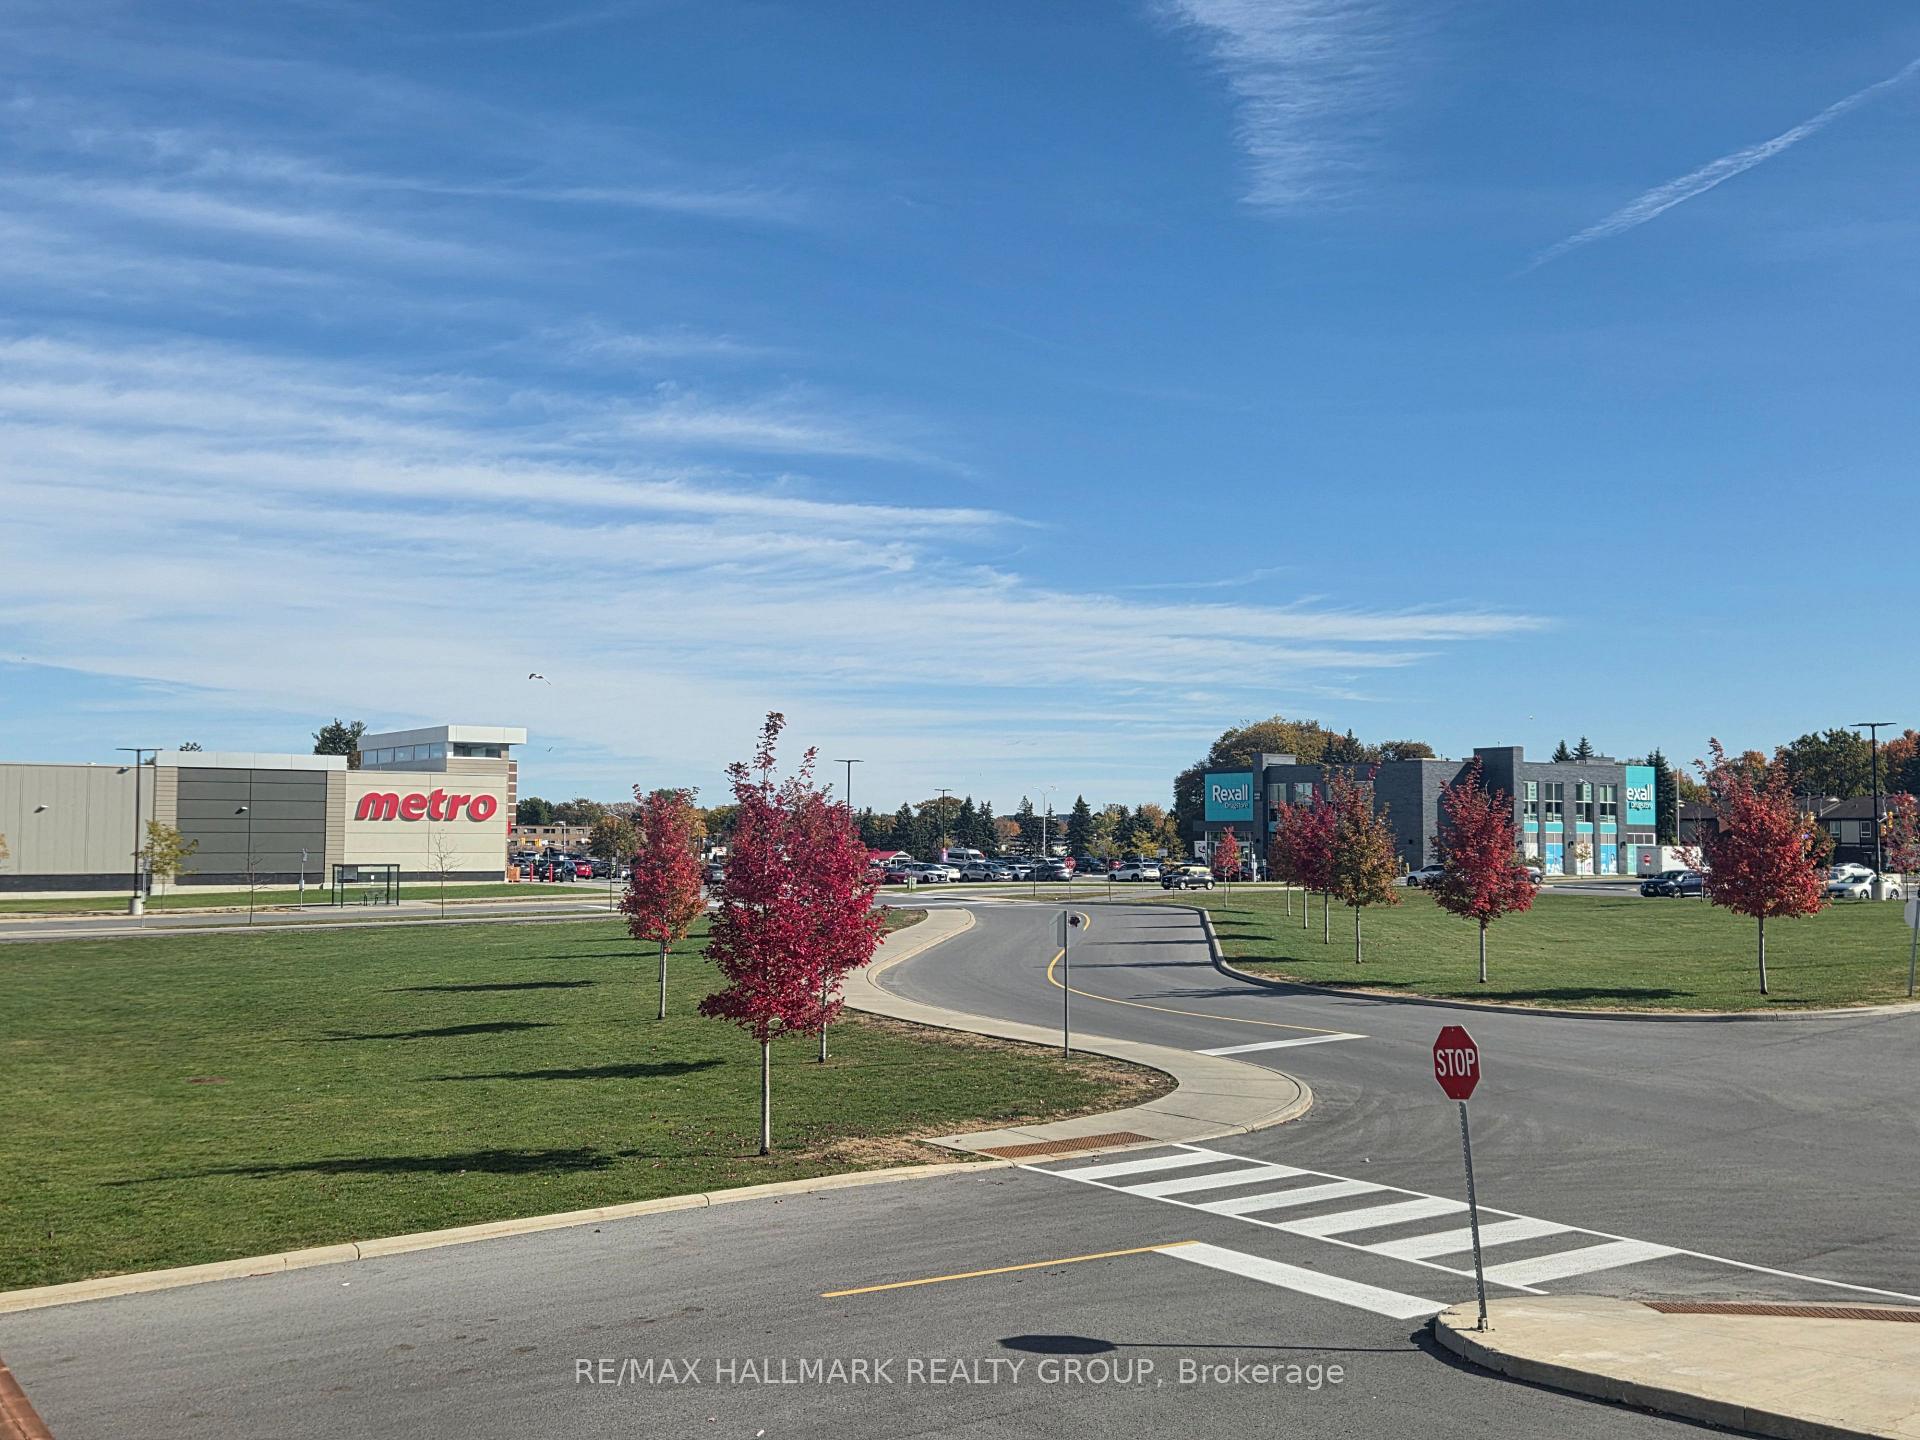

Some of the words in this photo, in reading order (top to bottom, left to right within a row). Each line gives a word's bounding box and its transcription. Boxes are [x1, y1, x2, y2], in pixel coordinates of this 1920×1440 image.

[1212, 783, 1248, 803] Rexall
[1626, 783, 1653, 801] exall
[356, 788, 498, 822] metro
[1436, 1048, 1476, 1077] STOP
